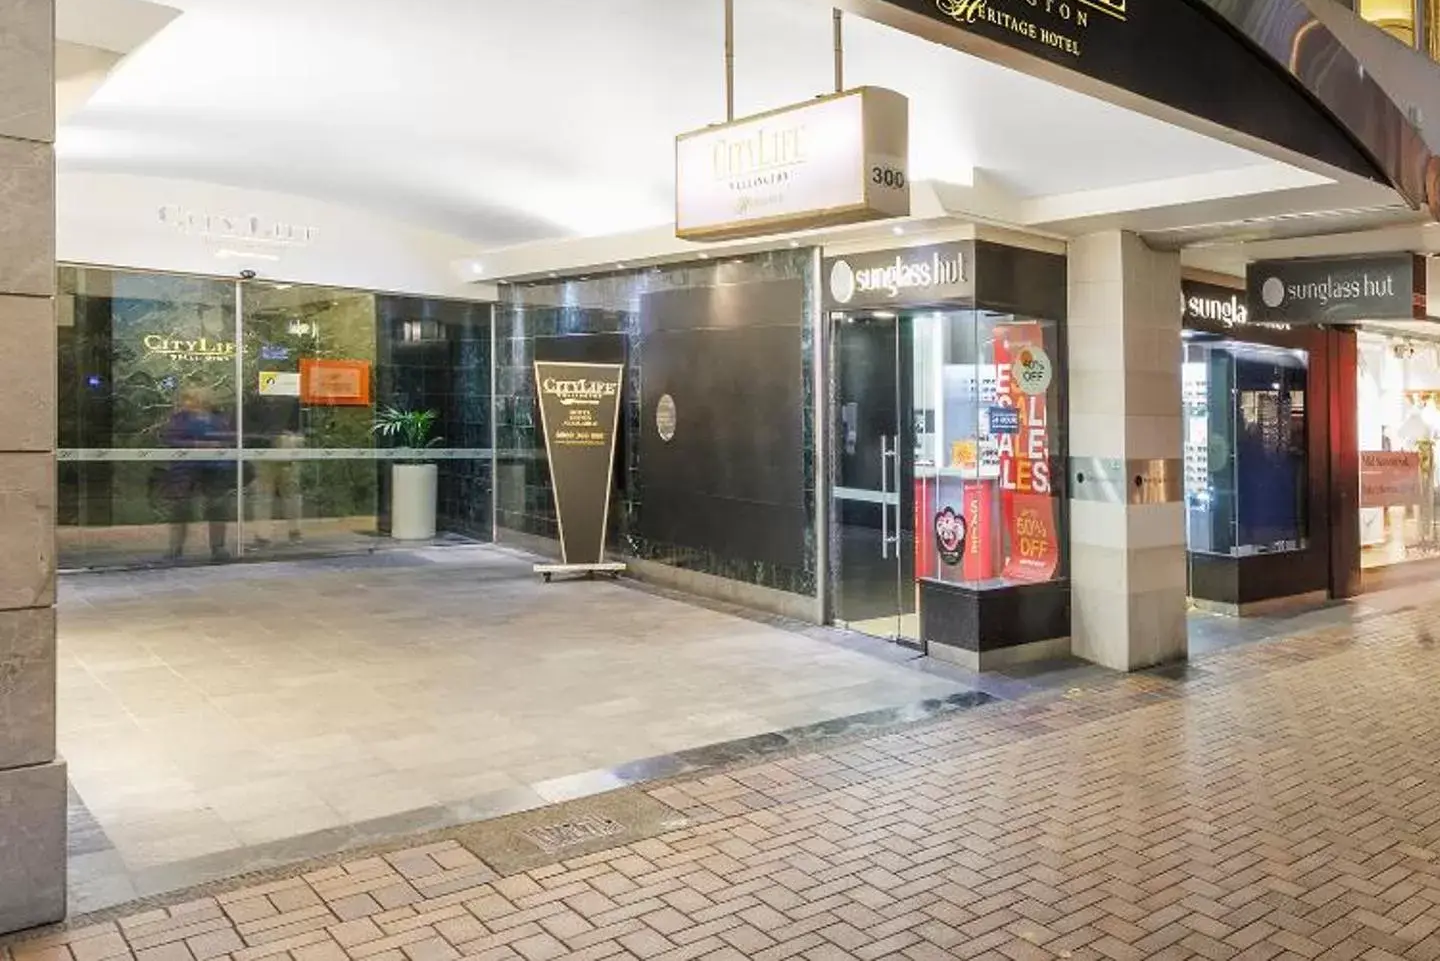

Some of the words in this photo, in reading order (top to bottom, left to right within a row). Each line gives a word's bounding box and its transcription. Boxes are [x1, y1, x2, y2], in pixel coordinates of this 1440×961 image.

[1040, 27, 1081, 57] HOTEL
[872, 166, 905, 189] 300
[856, 255, 932, 298] sunglass
[934, 252, 968, 285] hut
[1287, 275, 1360, 306] sunglass
[1363, 274, 1395, 297] hut
[1188, 293, 1248, 328] sungla
[1022, 371, 1044, 383] OFF
[1020, 537, 1048, 558] OFF
